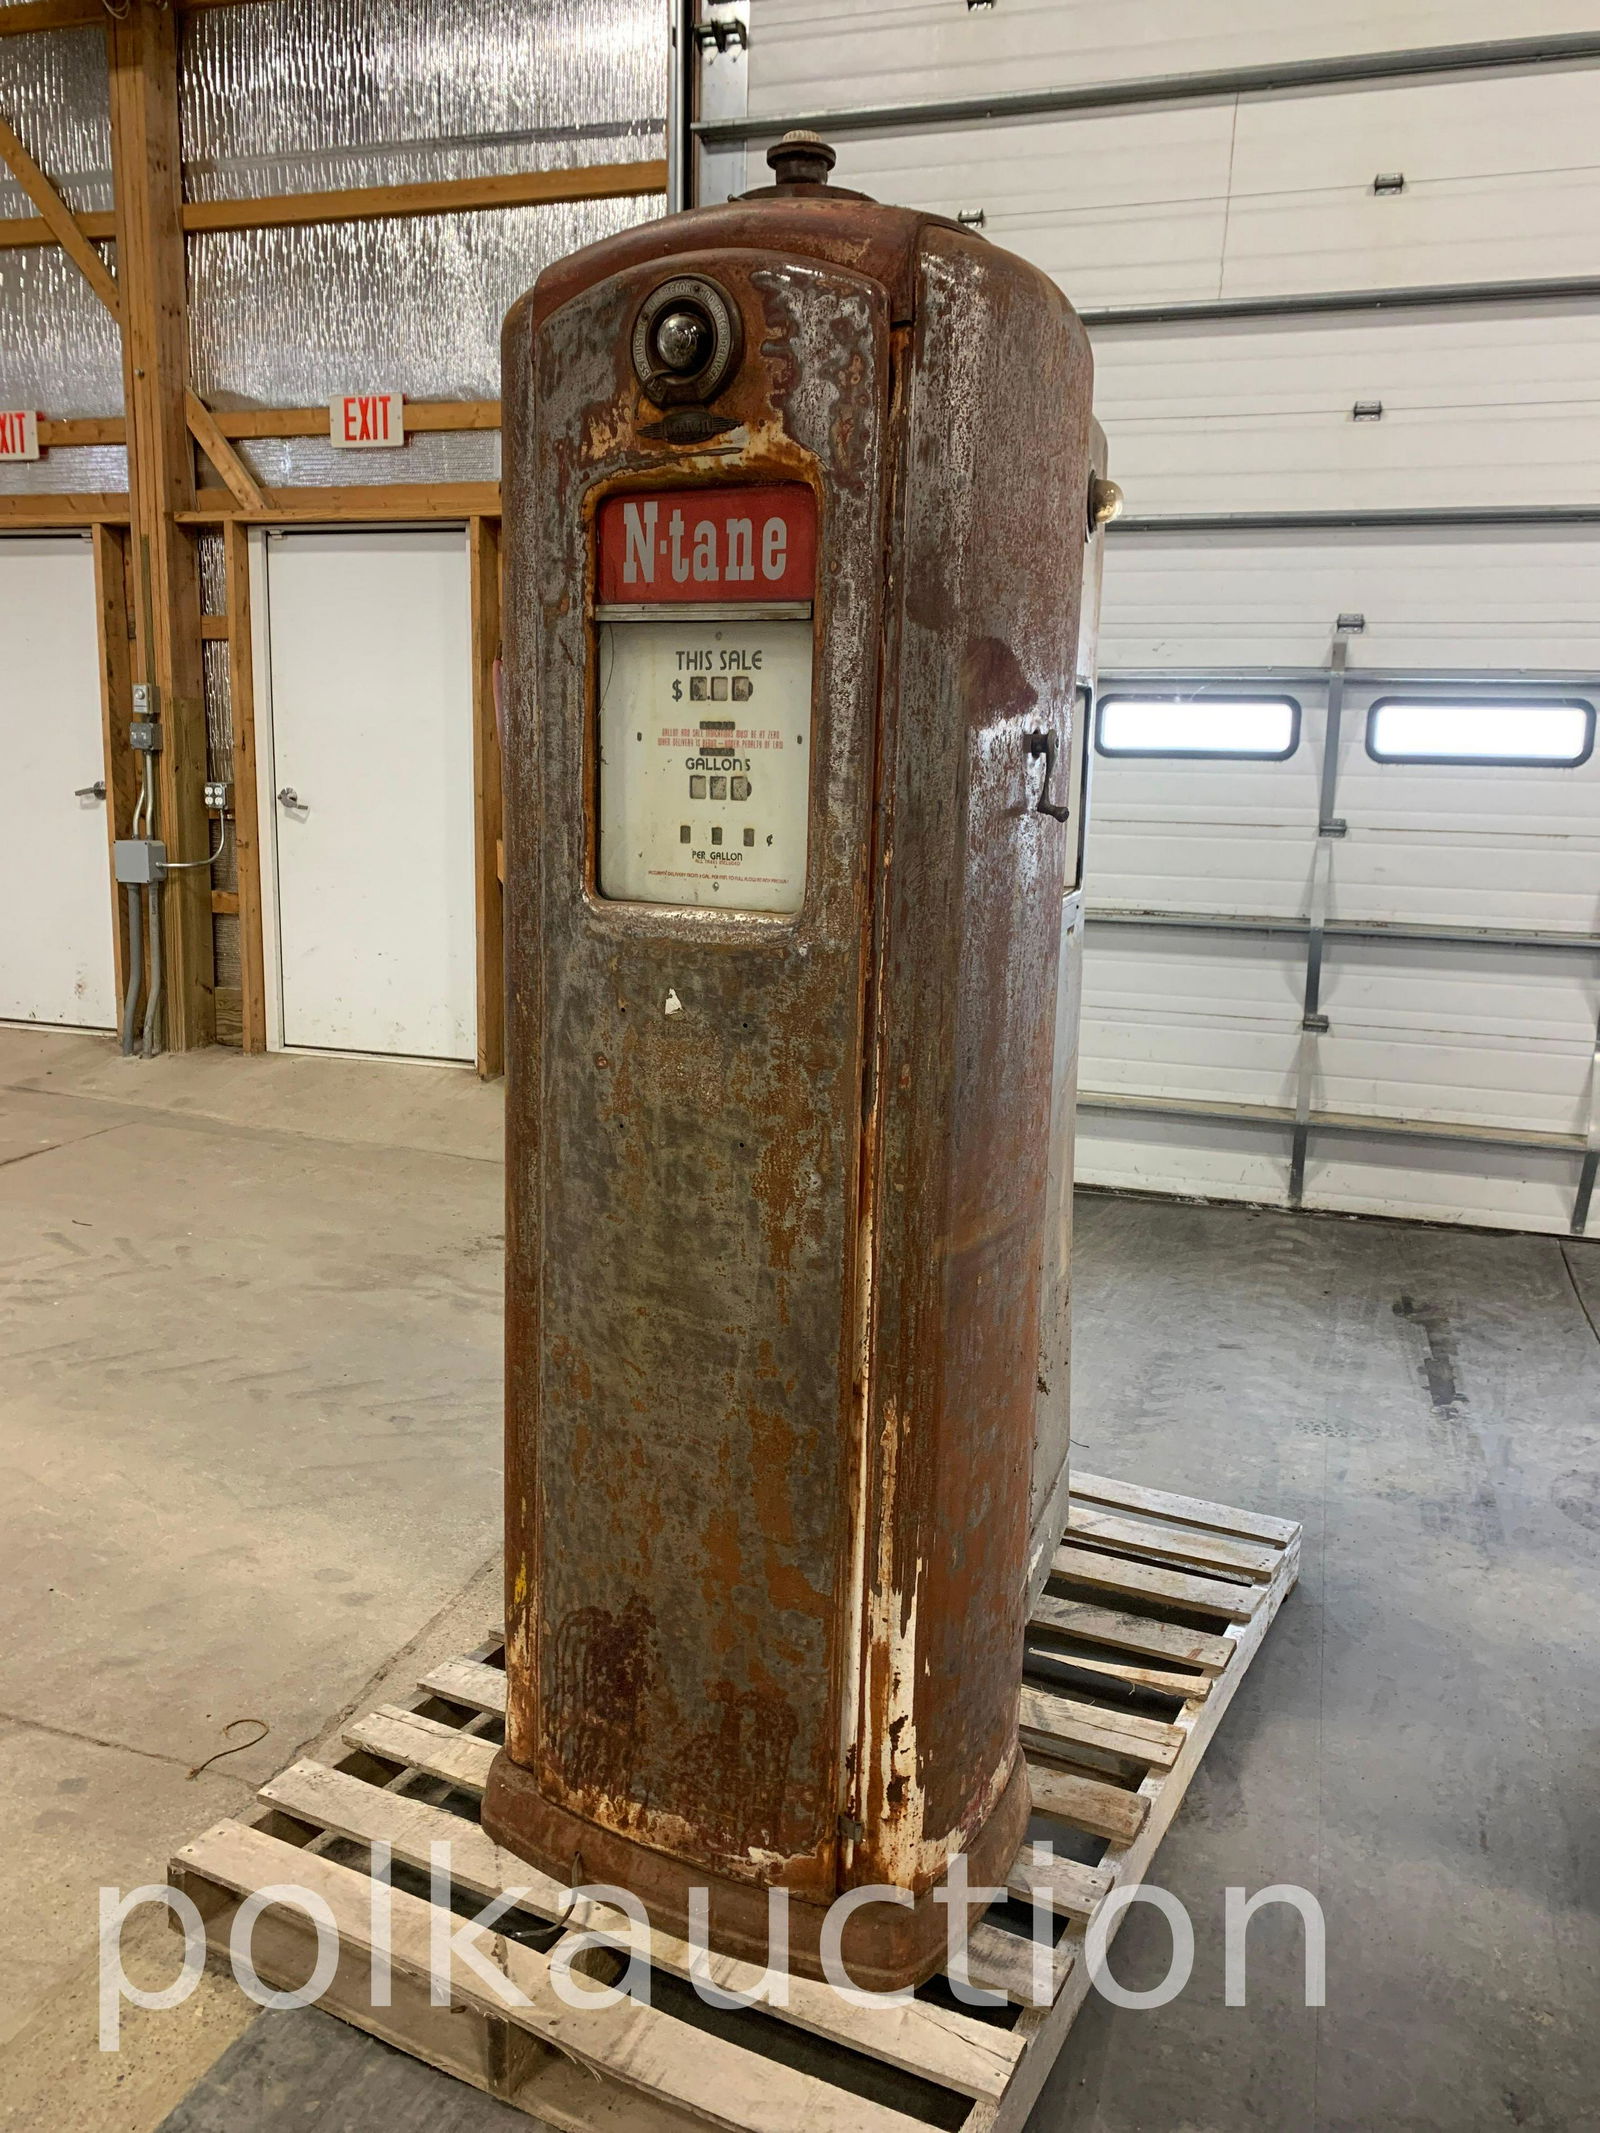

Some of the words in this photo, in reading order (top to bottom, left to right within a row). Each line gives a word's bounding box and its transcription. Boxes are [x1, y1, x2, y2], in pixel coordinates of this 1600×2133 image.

[344, 396, 391, 442] EXIT
[0, 412, 25, 454] XIT
[676, 650, 713, 671] THIS
[720, 649, 763, 671] SALE
[685, 758, 751, 771] GALLONS
[692, 850, 706, 860] PER
[710, 851, 743, 861] GALLON
